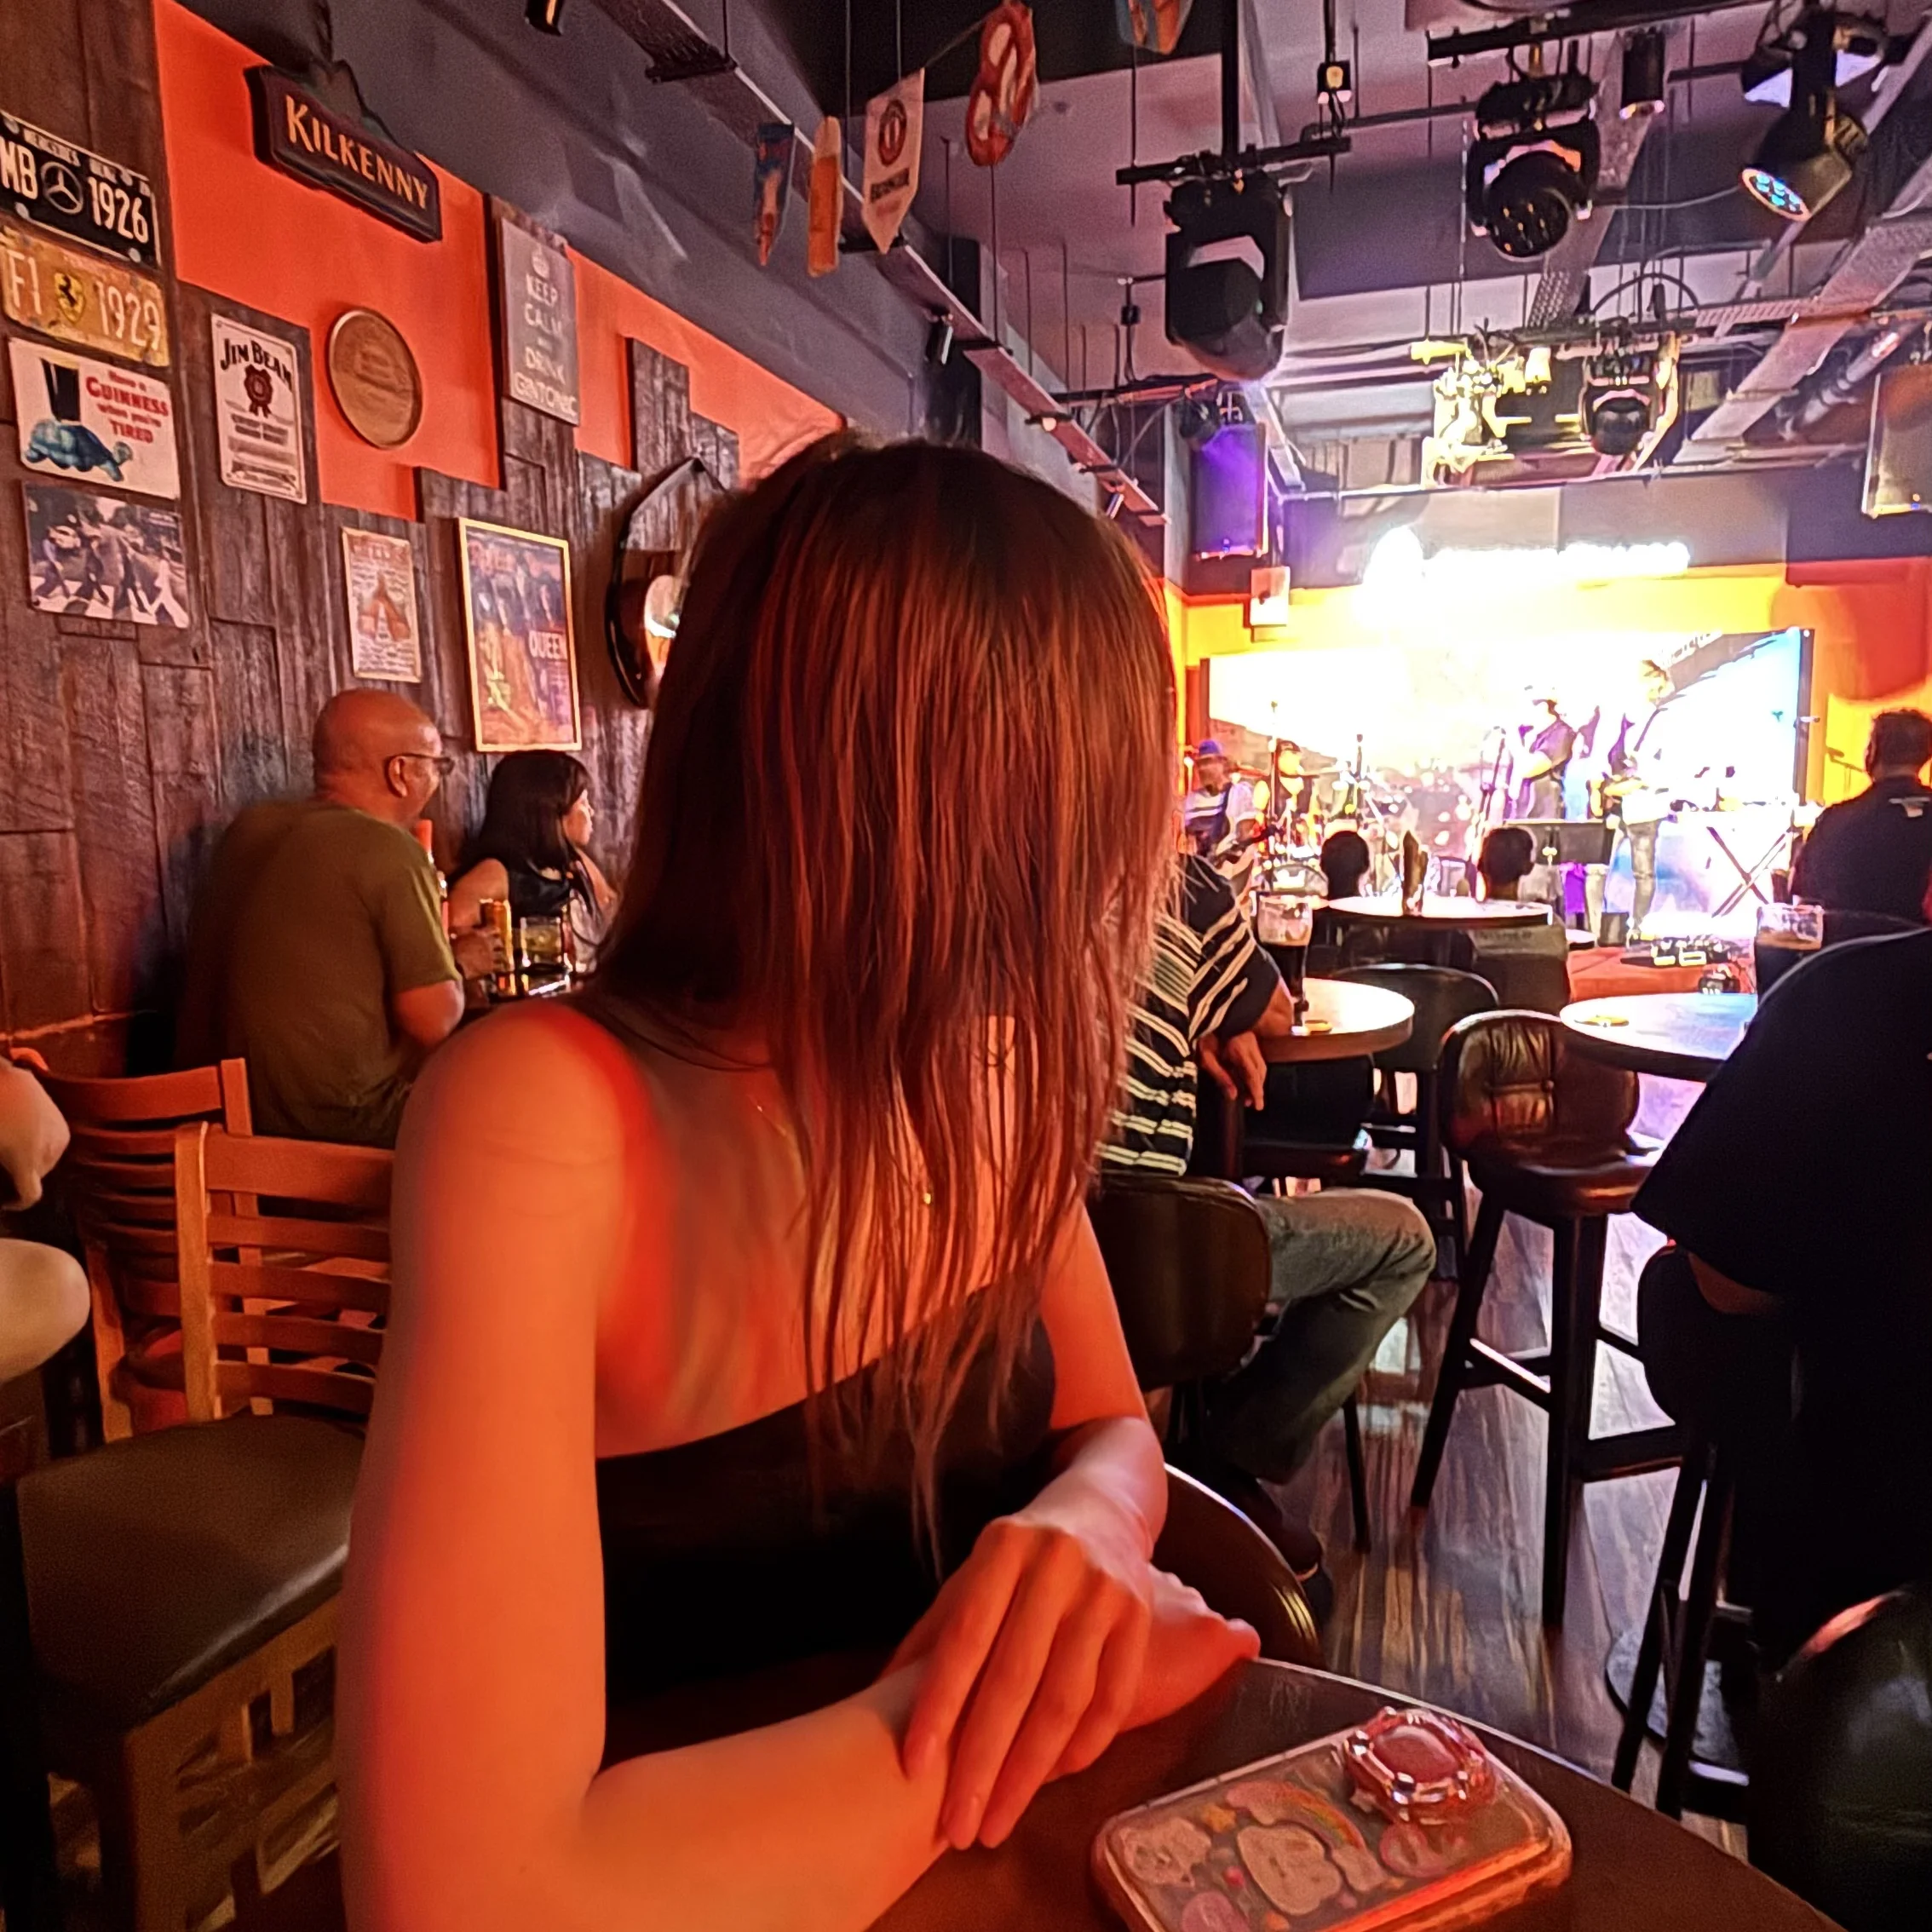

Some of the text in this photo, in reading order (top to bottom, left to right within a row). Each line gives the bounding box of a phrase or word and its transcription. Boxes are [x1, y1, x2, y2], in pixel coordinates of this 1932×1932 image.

[0, 135, 38, 200] MB
[88, 176, 149, 244] 1926
[286, 95, 428, 210] KILKENNY
[7, 249, 162, 351] F1 1929
[86, 376, 169, 417] GUINNESS
[251, 340, 292, 394] BEAM
[528, 629, 568, 661] QUEEN
